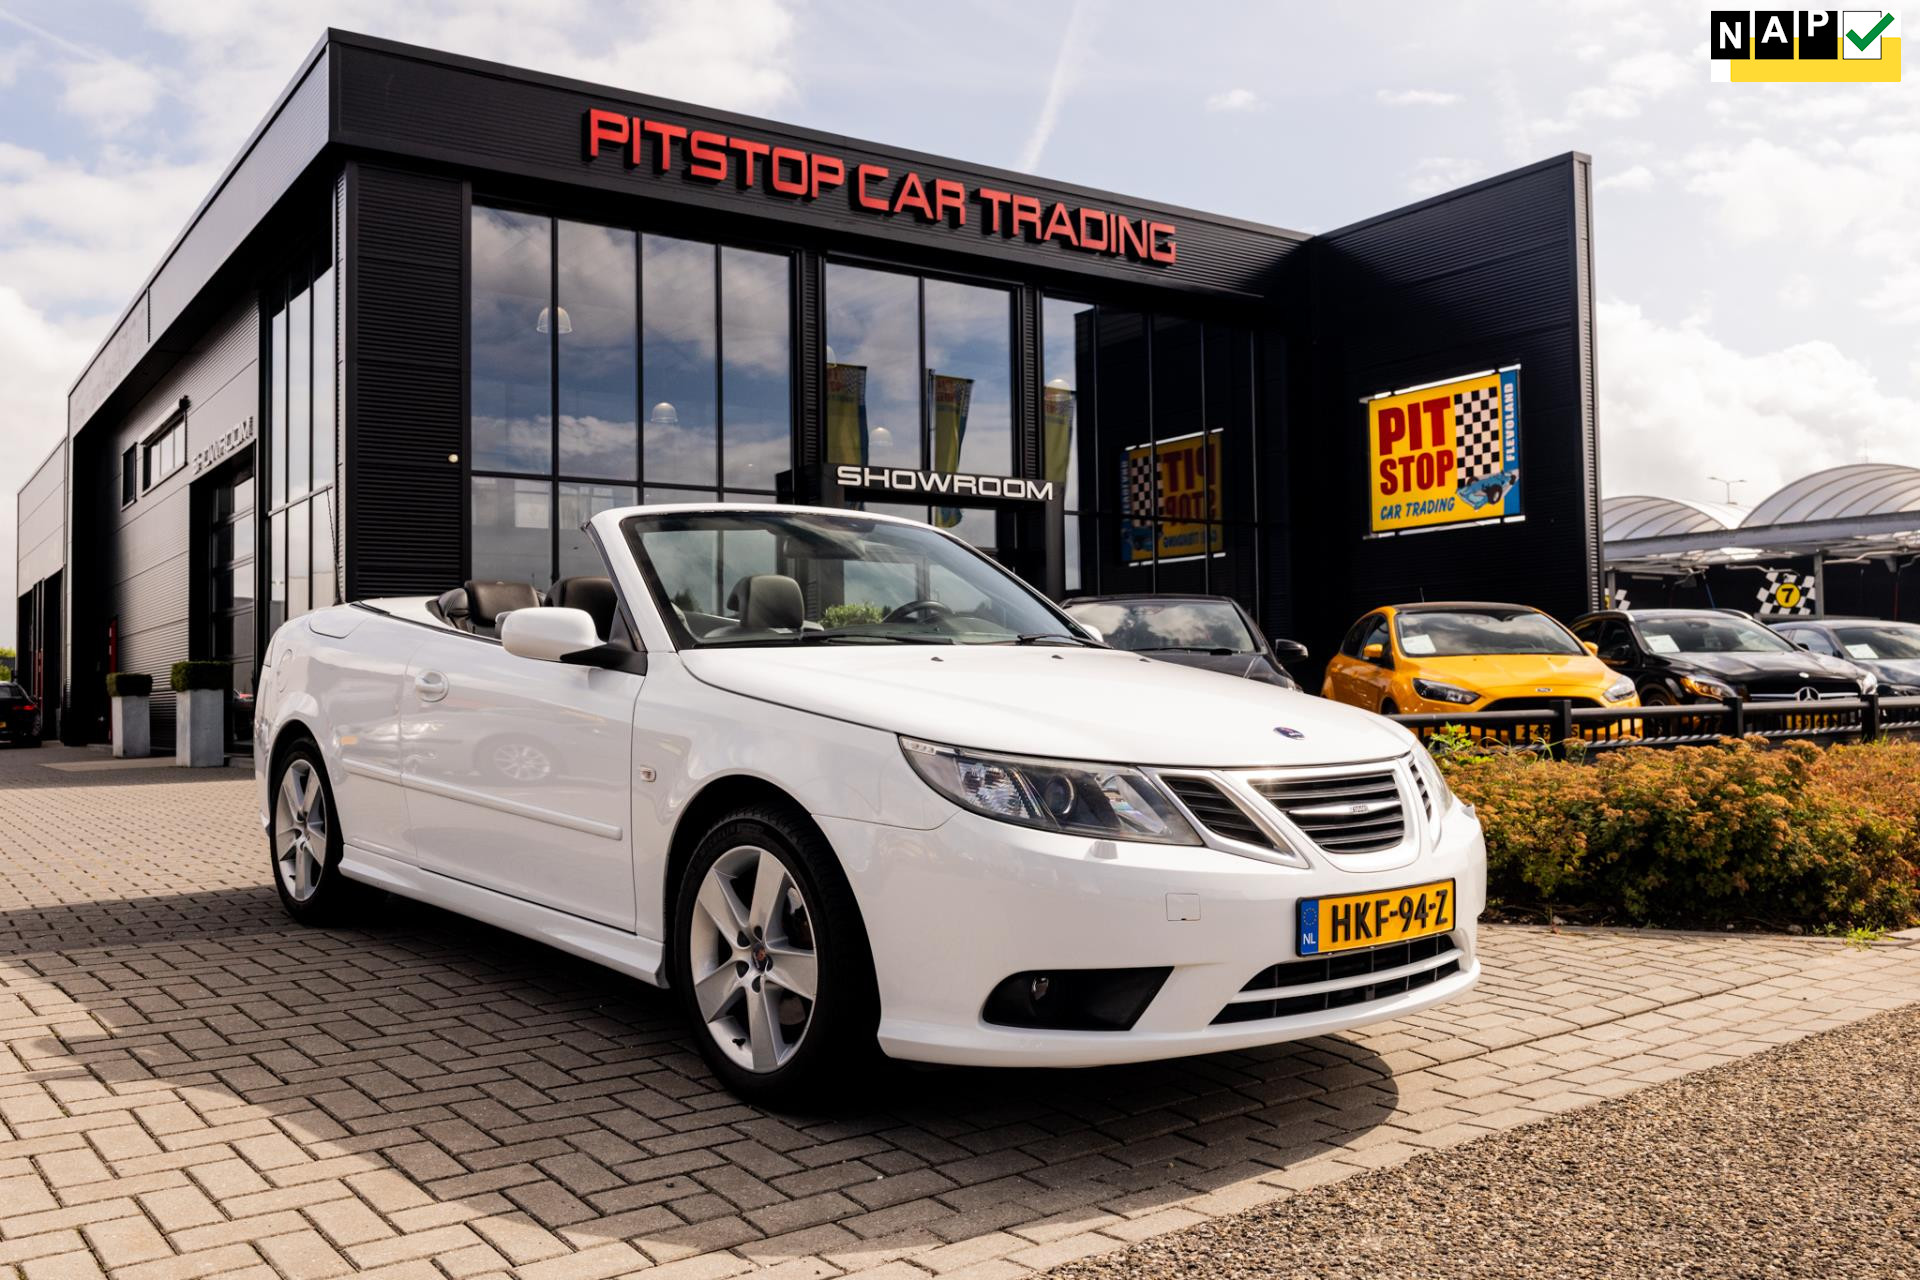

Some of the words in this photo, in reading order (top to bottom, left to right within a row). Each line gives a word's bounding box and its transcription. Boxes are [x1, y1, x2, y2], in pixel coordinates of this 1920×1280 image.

[589, 108, 845, 199] PITSTOP
[858, 163, 966, 225] CAR
[979, 187, 1176, 264] TRADING
[1378, 396, 1451, 456] PIT
[1504, 383, 1515, 462] FLEVOLAND
[836, 465, 1054, 501] SHOWROOM
[1379, 449, 1454, 496] STOP
[1380, 504, 1401, 521] CAR
[1405, 497, 1456, 517] TRADING
[1780, 587, 1795, 603] 7
[1303, 932, 1316, 945] NL
[1331, 889, 1448, 943] HKF-94-Z
